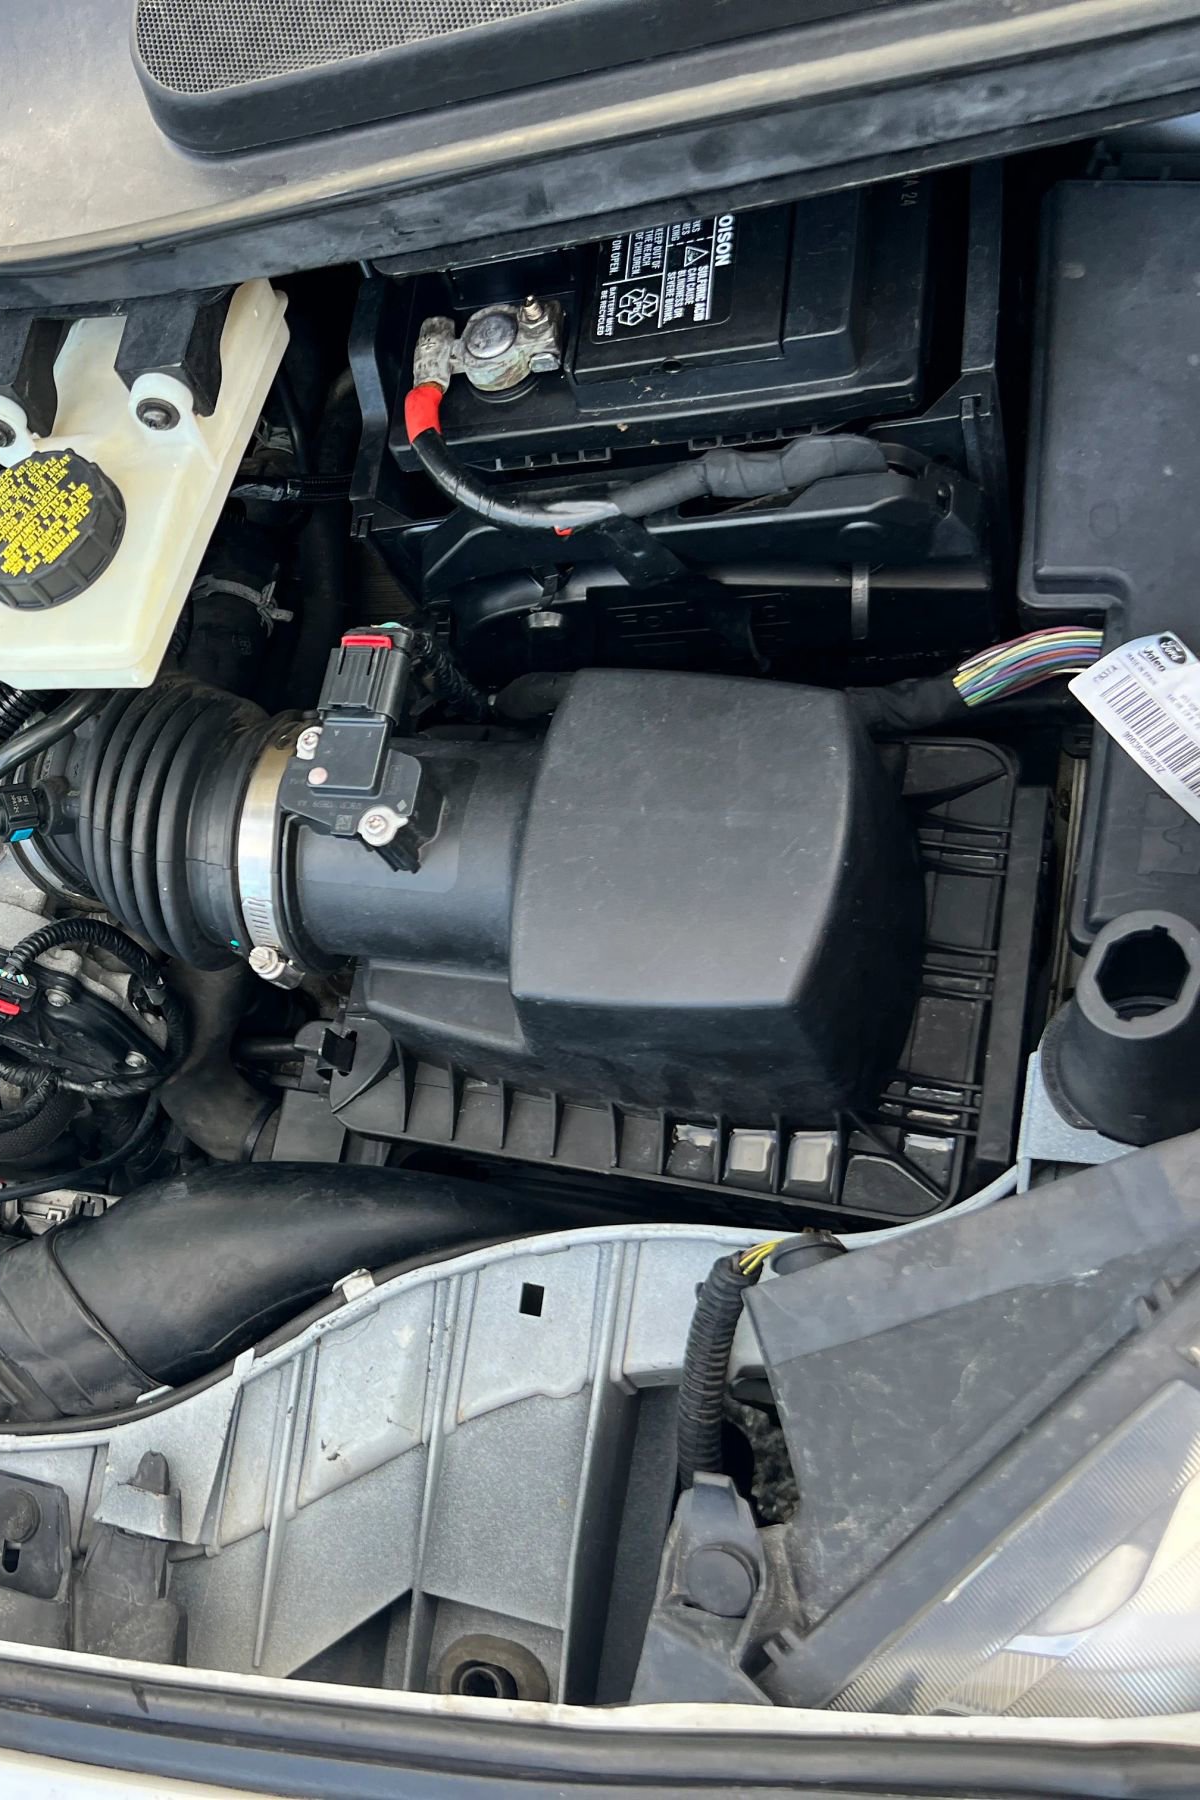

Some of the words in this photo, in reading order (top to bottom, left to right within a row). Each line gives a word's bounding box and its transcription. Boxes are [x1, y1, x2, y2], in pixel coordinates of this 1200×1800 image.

[612, 240, 622, 250] OR
[644, 230, 654, 243] THE
[654, 228, 664, 244] KEEP
[715, 214, 734, 266] OISON
[642, 244, 652, 266] REACH
[652, 245, 662, 260] OUT
[651, 260, 661, 269] OF
[687, 268, 697, 282] CAN
[665, 272, 677, 297] SEVERE
[675, 270, 687, 307] BLINDNESS
[695, 265, 709, 300] SULFURIC
[600, 290, 608, 300] BE
[607, 286, 617, 316] BATTERY
[685, 282, 696, 306] CAUSE
[596, 300, 607, 336] RECYCLED
[673, 307, 685, 318] OR
[693, 301, 706, 322] ACID
[605, 316, 614, 336] MUST
[1160, 639, 1183, 662] Ford
